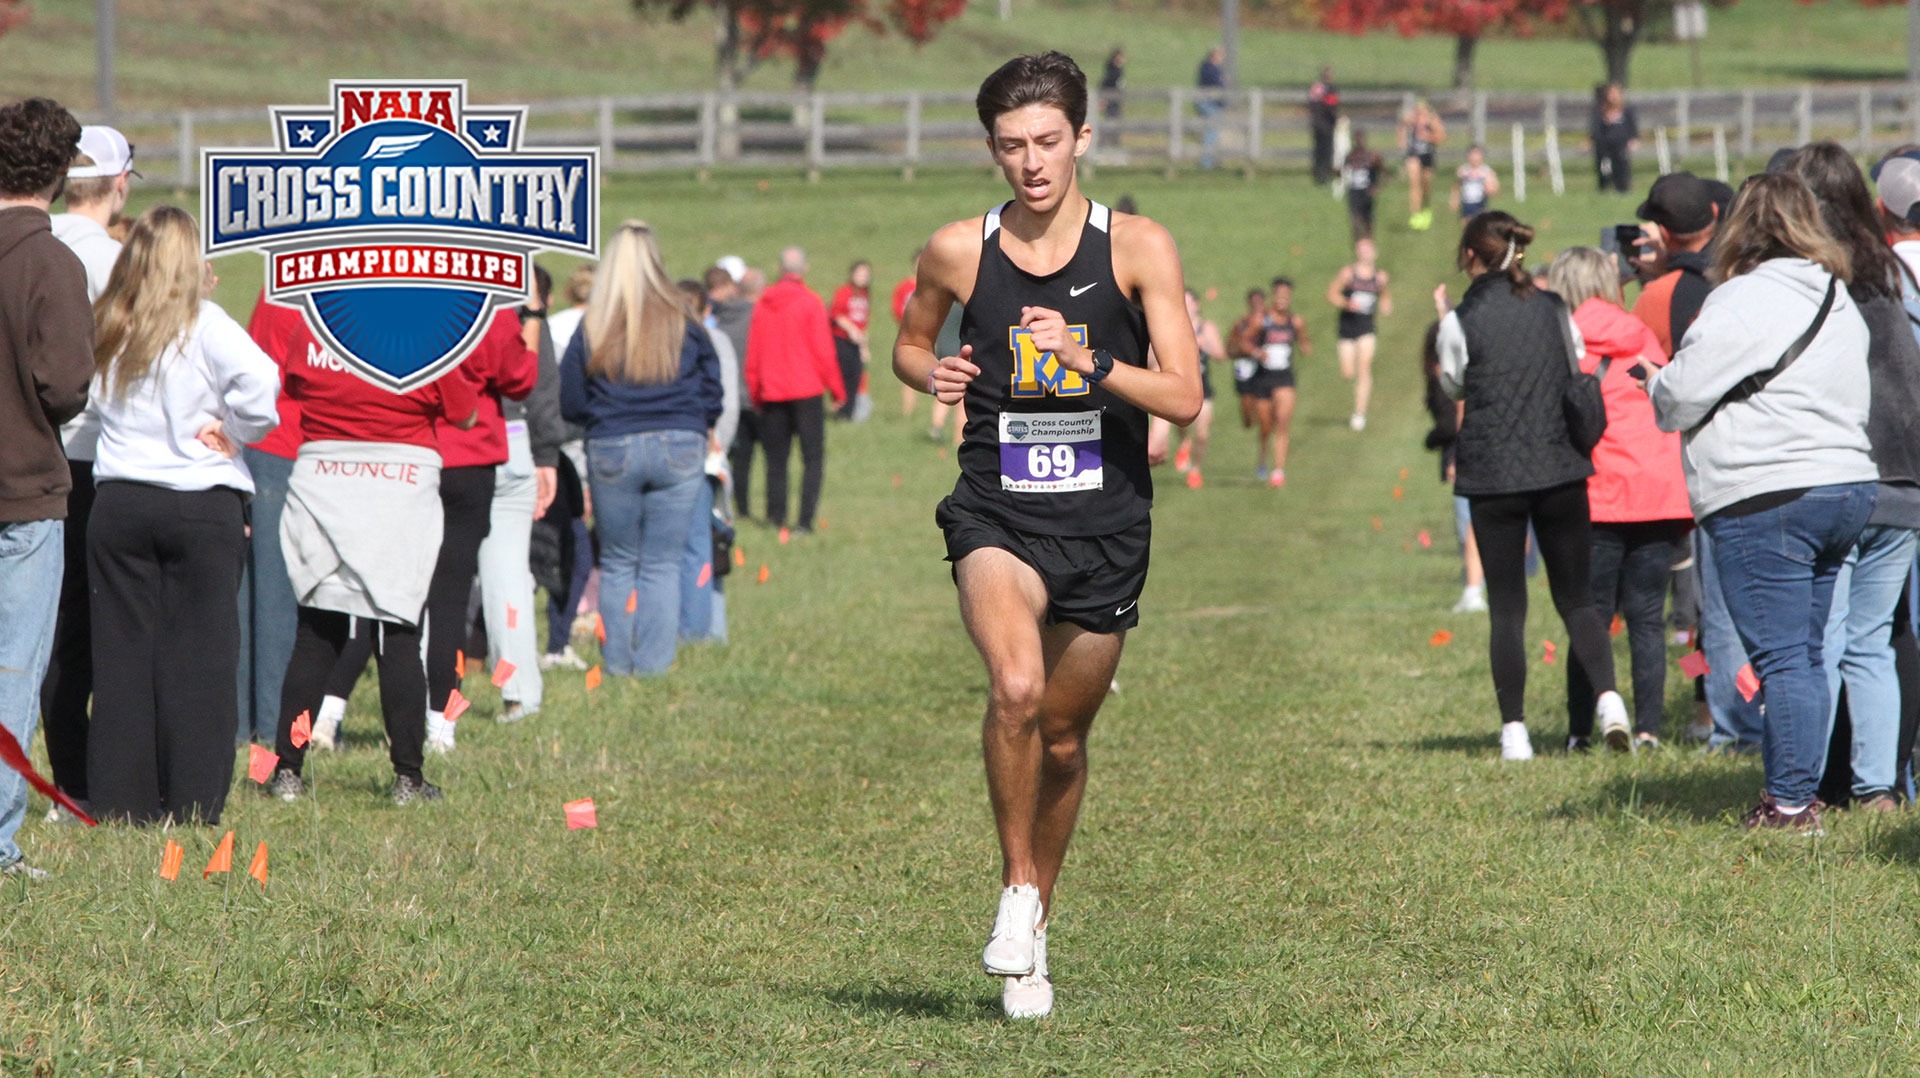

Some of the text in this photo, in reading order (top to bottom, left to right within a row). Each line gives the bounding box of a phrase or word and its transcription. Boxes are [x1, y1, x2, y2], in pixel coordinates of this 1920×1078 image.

[1031, 418, 1094, 427] Cross Country
[1031, 427, 1095, 437] Championship
[1028, 444, 1076, 478] 69
